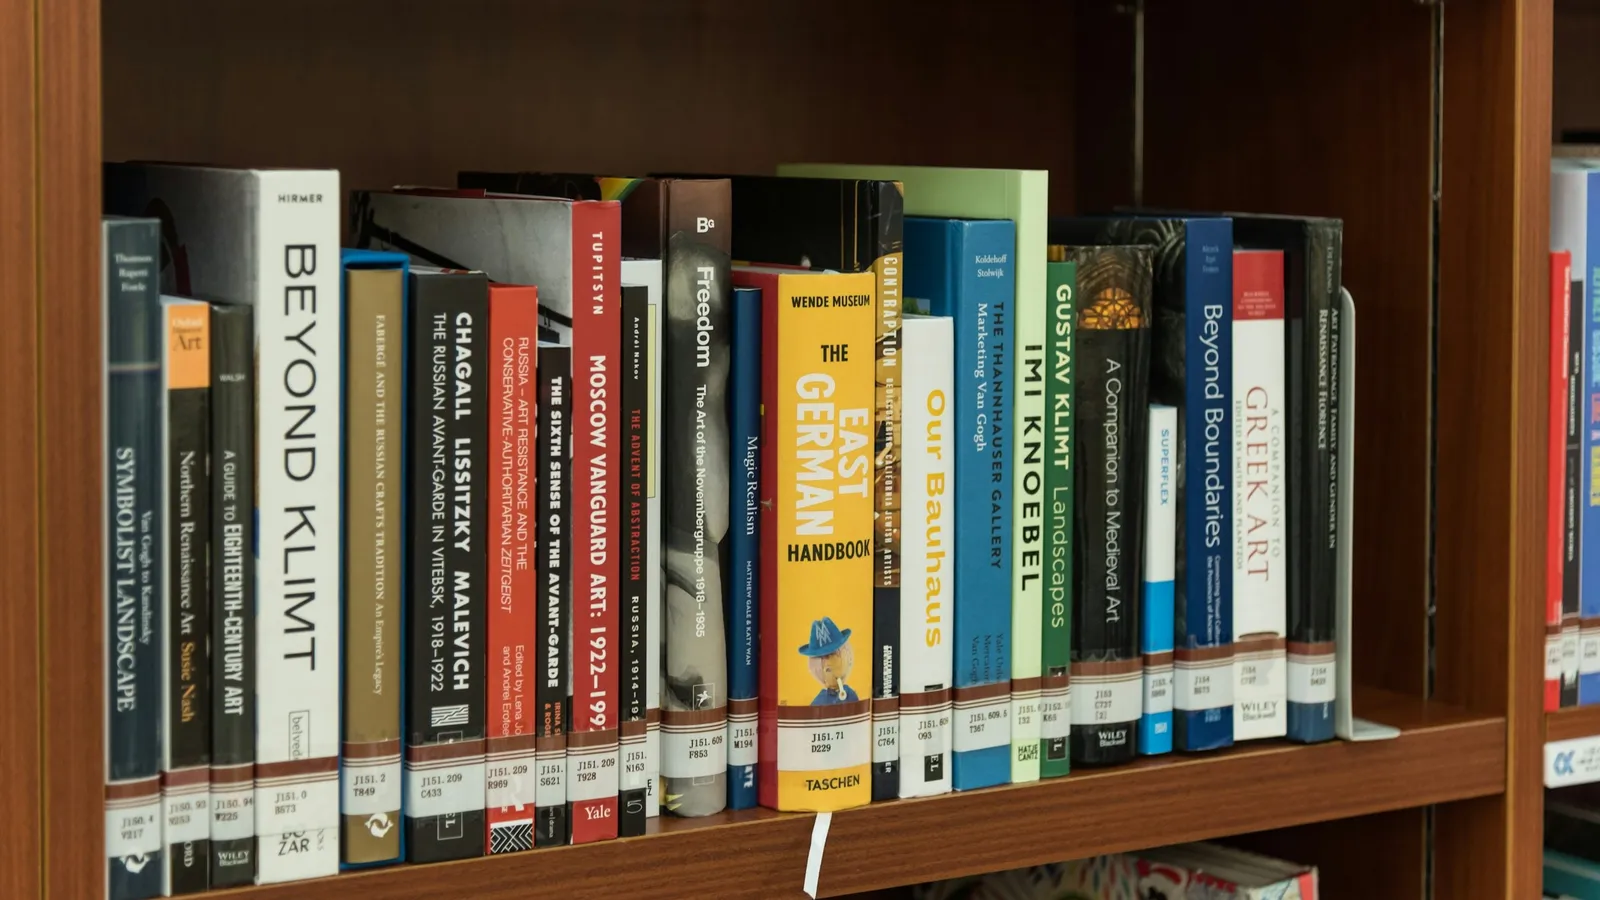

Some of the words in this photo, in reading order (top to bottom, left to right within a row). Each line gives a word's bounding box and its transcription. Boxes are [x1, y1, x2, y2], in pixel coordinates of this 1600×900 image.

[278, 194, 323, 204] HIRMER
[592, 232, 604, 314] TUPITSYN
[975, 254, 1007, 264] Koldehoff
[978, 268, 1004, 278] Stolwijk
[696, 266, 714, 367] Freedom
[792, 296, 829, 308] WENDE
[832, 295, 870, 307] MUSEUM
[883, 257, 898, 366] CONTRAPTION
[433, 312, 447, 340] THE
[994, 302, 1004, 336] THE
[1055, 284, 1072, 384] GUSTAV
[174, 334, 202, 351] Art
[820, 344, 848, 362] THE
[974, 303, 988, 378] Marketing
[1199, 304, 1224, 399] Beyond
[219, 374, 245, 382] WALSH
[284, 244, 316, 482] BEYOND
[432, 346, 447, 410] RUSSIAN
[454, 312, 472, 420] CHAGALL
[518, 338, 530, 386] RUSSIA
[1024, 345, 1043, 396] IMI
[1106, 358, 1122, 374] A
[376, 372, 386, 398] AND
[551, 376, 562, 406] THE
[590, 356, 607, 448] MOSCOW
[696, 384, 706, 408] The
[976, 382, 987, 409] Van
[376, 401, 386, 426] THE
[518, 399, 528, 426] ART
[631, 410, 640, 430] THE
[696, 410, 706, 430] Art
[885, 378, 894, 446] REDISCOVERING
[926, 390, 946, 460] Our
[992, 342, 1004, 484] THANNHAUSER
[1271, 408, 1279, 416] A
[500, 338, 514, 544] CONSERVATIVE-AUTHORITARIAN
[550, 411, 562, 457] SIXTH
[696, 432, 706, 444] of
[974, 414, 987, 452] Gogh
[1054, 394, 1070, 470] KLIMT
[1103, 378, 1122, 484] Companion
[1236, 441, 1242, 453] BY
[1246, 386, 1268, 501] GREEK
[224, 450, 236, 460] A
[376, 429, 386, 479] RUSSIAN
[432, 415, 446, 520] AVANT-GARDE
[517, 429, 528, 510] RESISTANCE
[631, 435, 640, 478] ADVENT
[696, 446, 706, 466] the
[744, 436, 758, 478] Magic
[796, 373, 836, 536] GERMAN
[838, 408, 868, 498] EAST
[1160, 429, 1170, 506] SUPERFLEX
[180, 451, 195, 518] Northern
[224, 463, 236, 500] GUIDE
[550, 461, 562, 510] SENSE
[630, 483, 640, 496] OF
[884, 454, 893, 506] CALIFORNIA
[1204, 408, 1225, 548] Boundaries
[1271, 426, 1280, 527] COMPANION
[116, 448, 136, 574] SYMBOLIST
[376, 482, 386, 528] CRAFTS
[454, 438, 472, 552] LISSITZKY
[590, 453, 607, 566] VANGUARD
[746, 481, 758, 536] Realism
[1022, 416, 1042, 591] KNOEBEL
[1106, 489, 1120, 506] to
[141, 510, 152, 532] Van
[224, 505, 236, 522] TO
[517, 513, 528, 541] AND
[550, 514, 560, 535] OF
[694, 468, 706, 574] Novembergruppe
[884, 511, 892, 544] JEWISH
[991, 489, 1002, 569] GALLERY
[138, 534, 152, 568] Gogh
[432, 526, 445, 542] IN
[630, 502, 640, 581] ABSTRACTION
[788, 539, 870, 562] HANDBOOK
[1106, 512, 1121, 590] Medieval
[1248, 514, 1268, 582] ART
[1272, 537, 1280, 558] TO
[180, 522, 195, 608] Renaissance
[376, 531, 385, 600] TRADITION
[516, 544, 528, 570] THE
[549, 539, 560, 568] THE
[884, 549, 892, 586] ARTISTS
[926, 472, 946, 648] Bauhaus
[1048, 487, 1068, 628] Landscapes
[141, 570, 150, 583] to
[284, 506, 316, 671] KLIMT
[429, 547, 445, 608] VITEBSK,
[500, 548, 512, 613] ZEITGEIST
[224, 524, 244, 682] EIGHTEENTH-CENTURY
[376, 604, 384, 618] An
[590, 573, 607, 618] ART:
[1106, 595, 1121, 624] Art
[138, 585, 152, 644] Kandinsky
[180, 612, 195, 635] Art
[453, 571, 470, 690] MALEVICH
[548, 574, 560, 688] AVANT-GARDE
[630, 596, 640, 654] RUSSIA,
[116, 580, 136, 712] LANDSCAPE
[180, 642, 195, 681] Susie
[502, 646, 512, 666] and
[515, 644, 524, 676] Edited
[972, 636, 980, 656] Van
[372, 662, 384, 696] Legacy
[502, 668, 512, 700] Andrei
[513, 680, 524, 692] by
[181, 684, 196, 722] Nash
[224, 686, 244, 715] ART
[514, 695, 524, 720] Lena
[1241, 701, 1278, 712] WILEY
[734, 740, 753, 748] M194
[878, 738, 895, 746] C764
[969, 724, 984, 734] T367
[1098, 730, 1128, 740] WILEY
[689, 750, 708, 759] F853
[811, 744, 831, 753] D229
[1018, 744, 1038, 754] HATJE
[1018, 752, 1038, 762] CANTZ
[488, 779, 508, 790] R969
[540, 777, 560, 787] S621
[577, 772, 597, 782] T928
[626, 763, 645, 773] N163
[806, 774, 860, 791] TASCHEN
[354, 787, 376, 797] T849
[420, 788, 442, 798] C433
[584, 804, 611, 820] Yale
[218, 850, 250, 860] WILEY
[278, 838, 310, 856] ZAR
